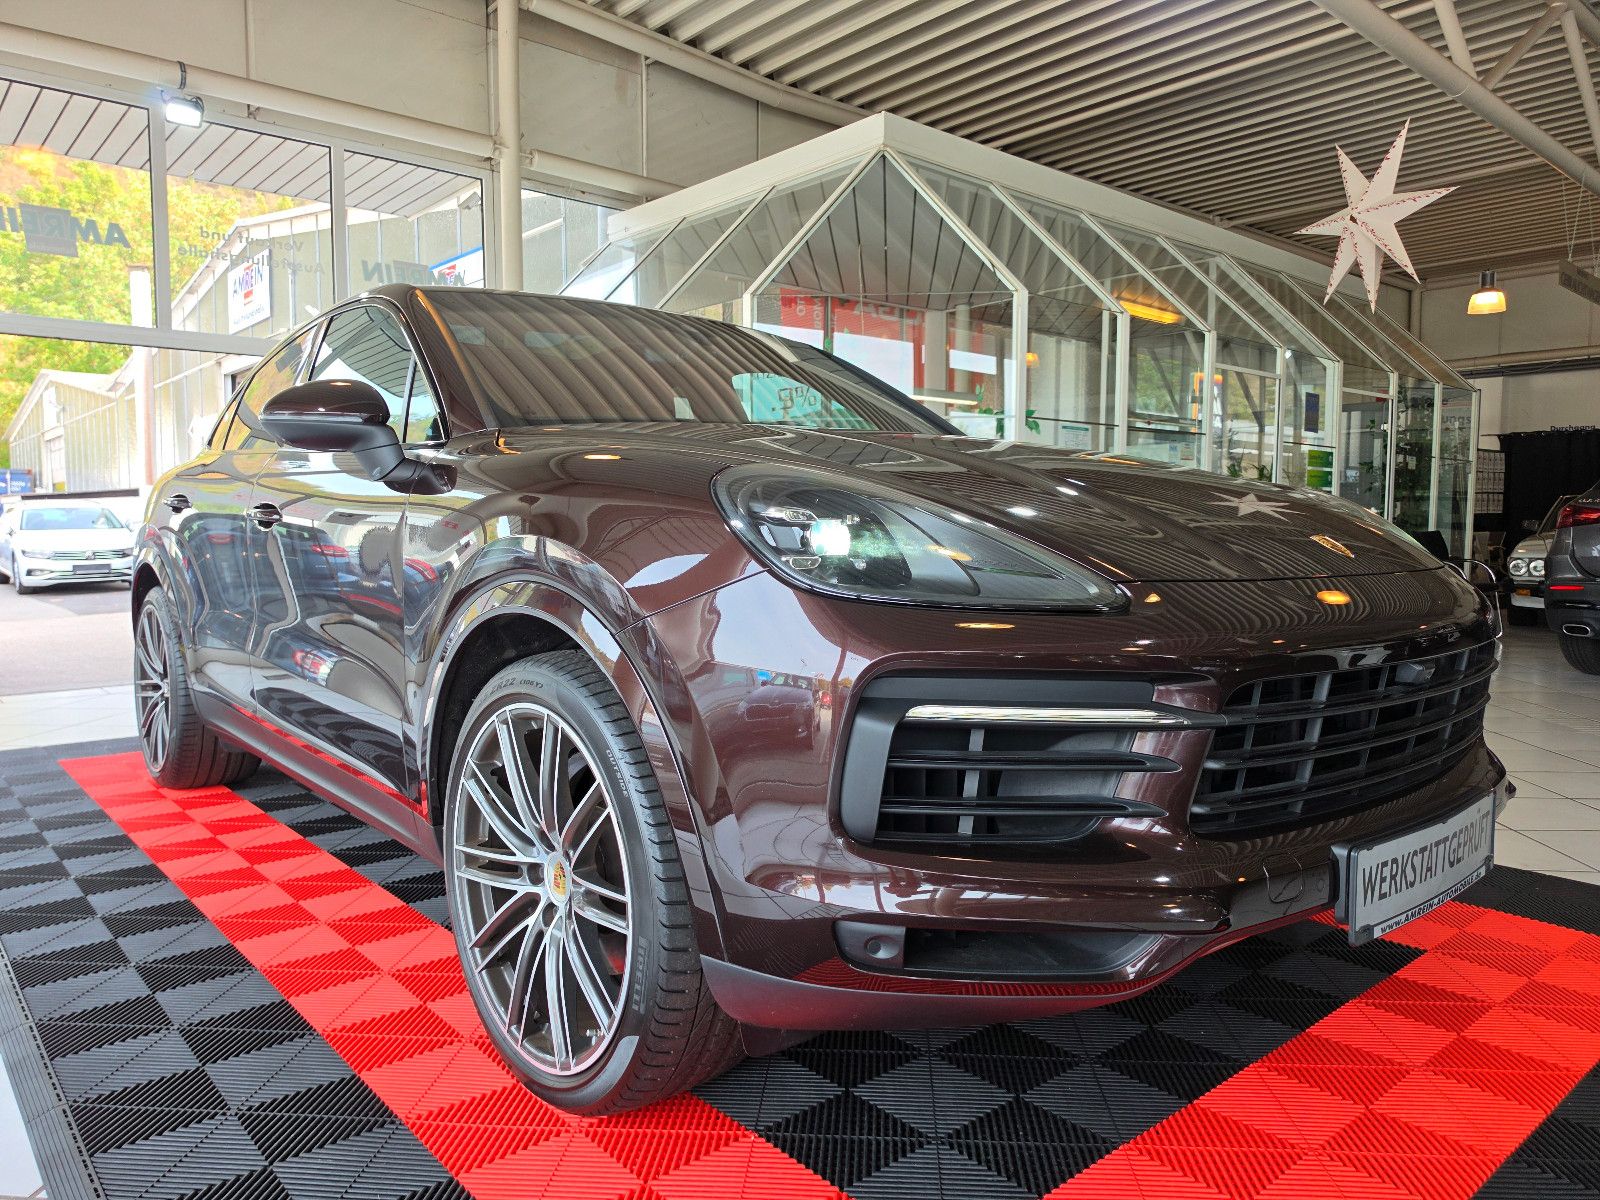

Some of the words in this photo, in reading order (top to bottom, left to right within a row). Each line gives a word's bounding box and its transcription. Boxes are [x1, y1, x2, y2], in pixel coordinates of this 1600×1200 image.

[232, 265, 263, 298] AMREIN
[606, 750, 629, 798] OUTSIDE
[1362, 808, 1491, 908] WERKSTATTGEPRÜFT
